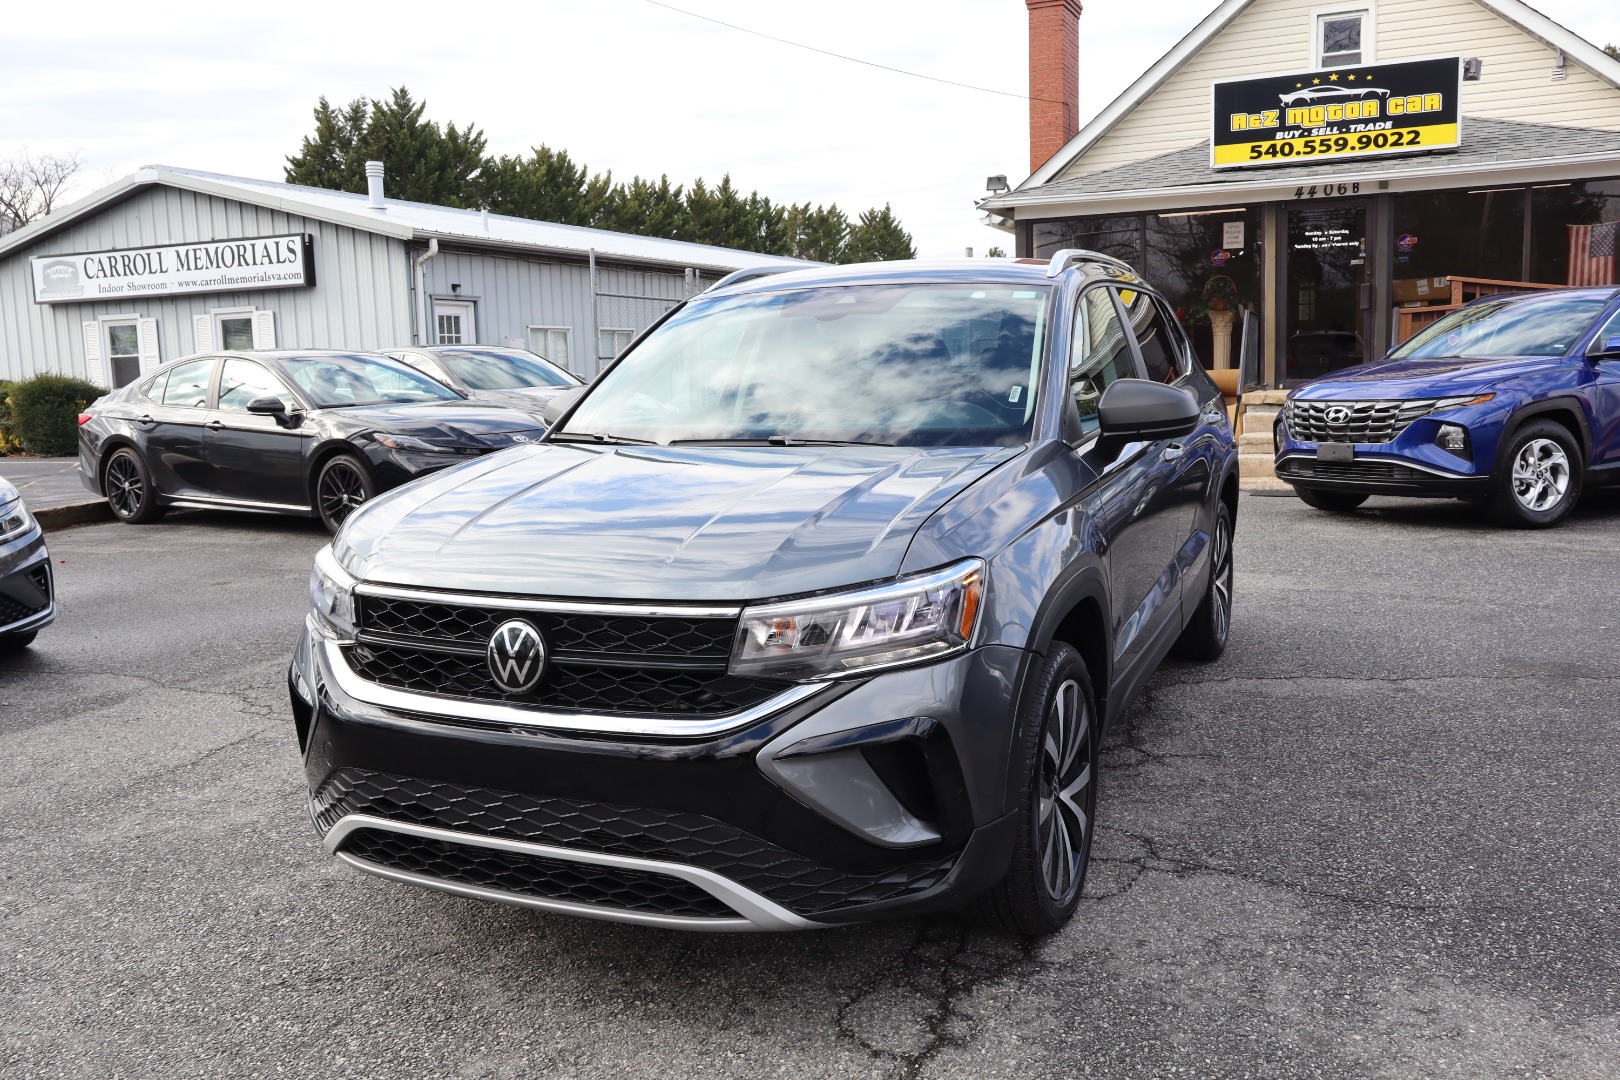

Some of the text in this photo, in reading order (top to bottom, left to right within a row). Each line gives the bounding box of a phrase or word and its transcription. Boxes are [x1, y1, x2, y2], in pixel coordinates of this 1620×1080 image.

[1275, 121, 1393, 139] BUY SELL TRADE
[1249, 130, 1420, 159] 540.559.9022
[84, 240, 297, 279] CARROLL MEMORIALS
[98, 271, 302, 294] Indoor Showroom www.carrollmemorialsva.com
